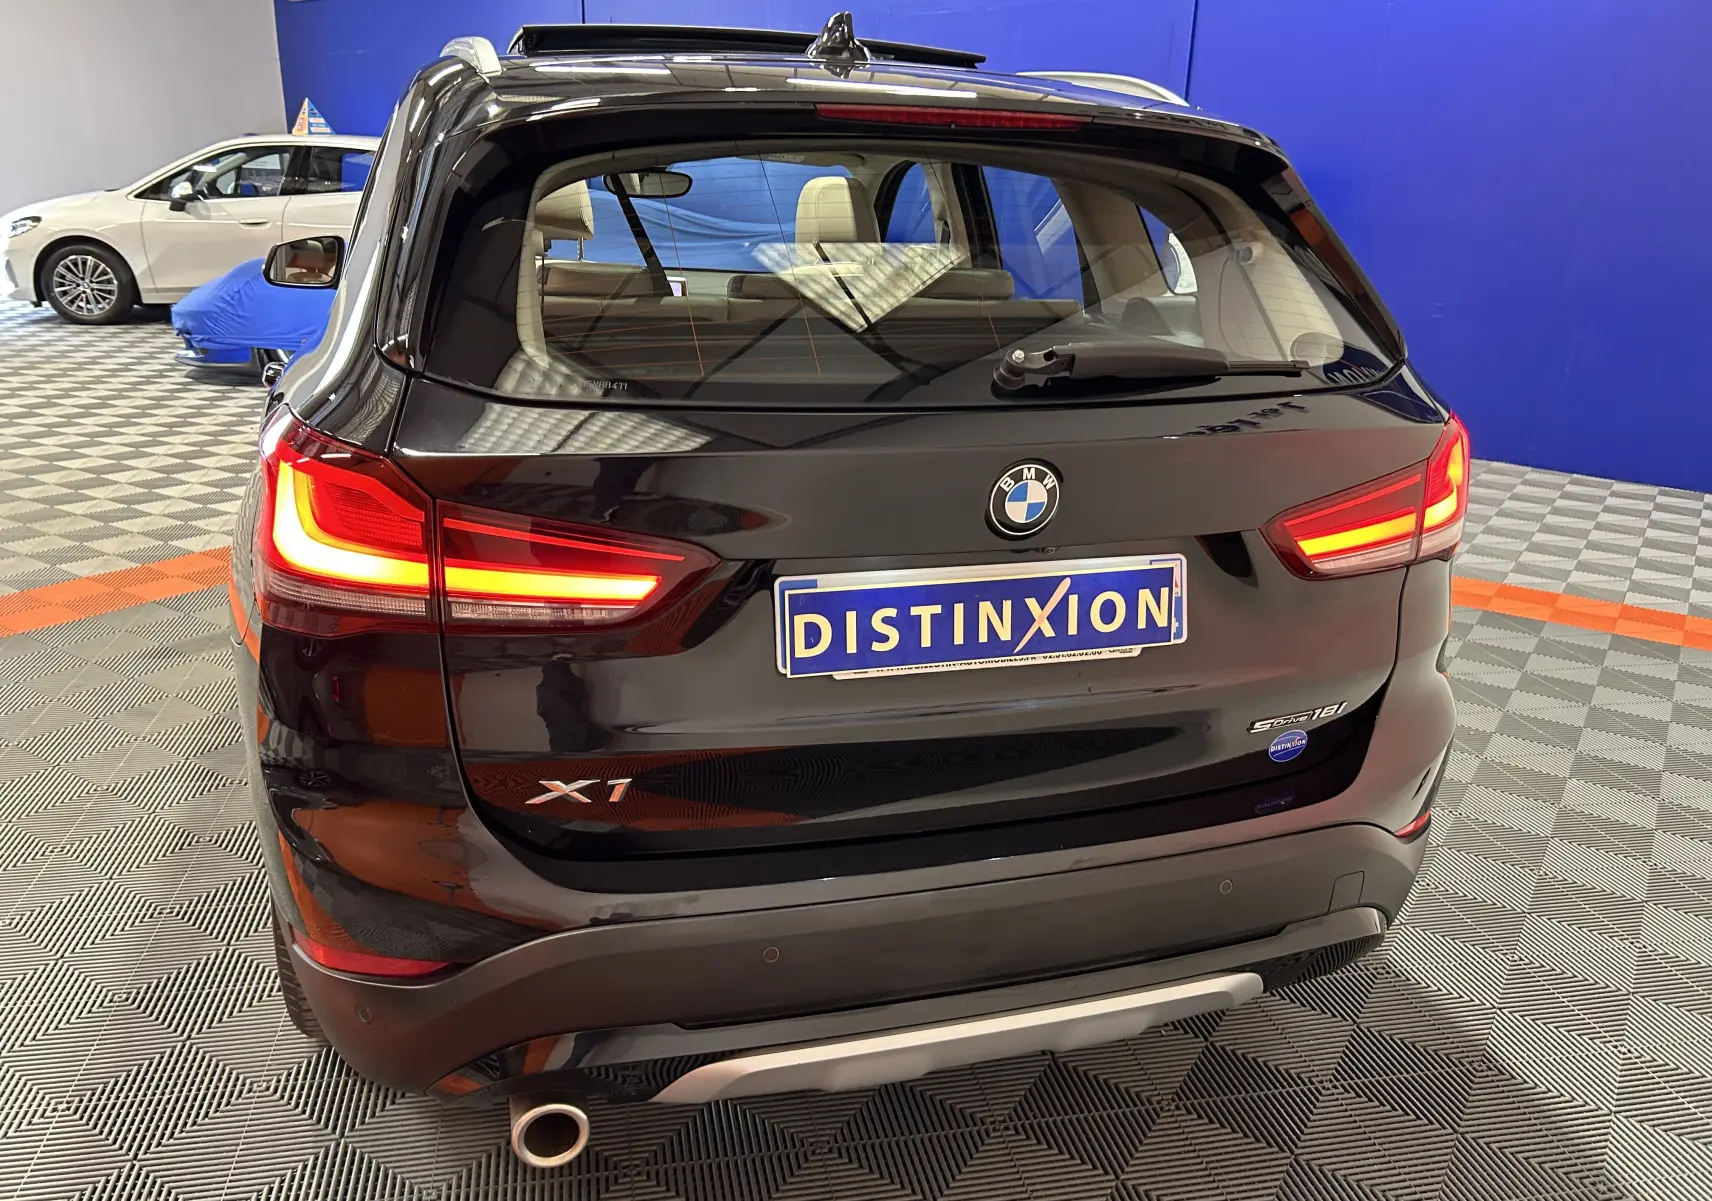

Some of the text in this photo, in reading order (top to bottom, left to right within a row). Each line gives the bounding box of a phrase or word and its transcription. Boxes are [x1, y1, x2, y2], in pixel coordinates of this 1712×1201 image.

[999, 467, 1056, 493] BMW
[793, 577, 1170, 659] DISTINXION
[1270, 737, 1306, 752] DISTINXION
[524, 778, 633, 805] X1
